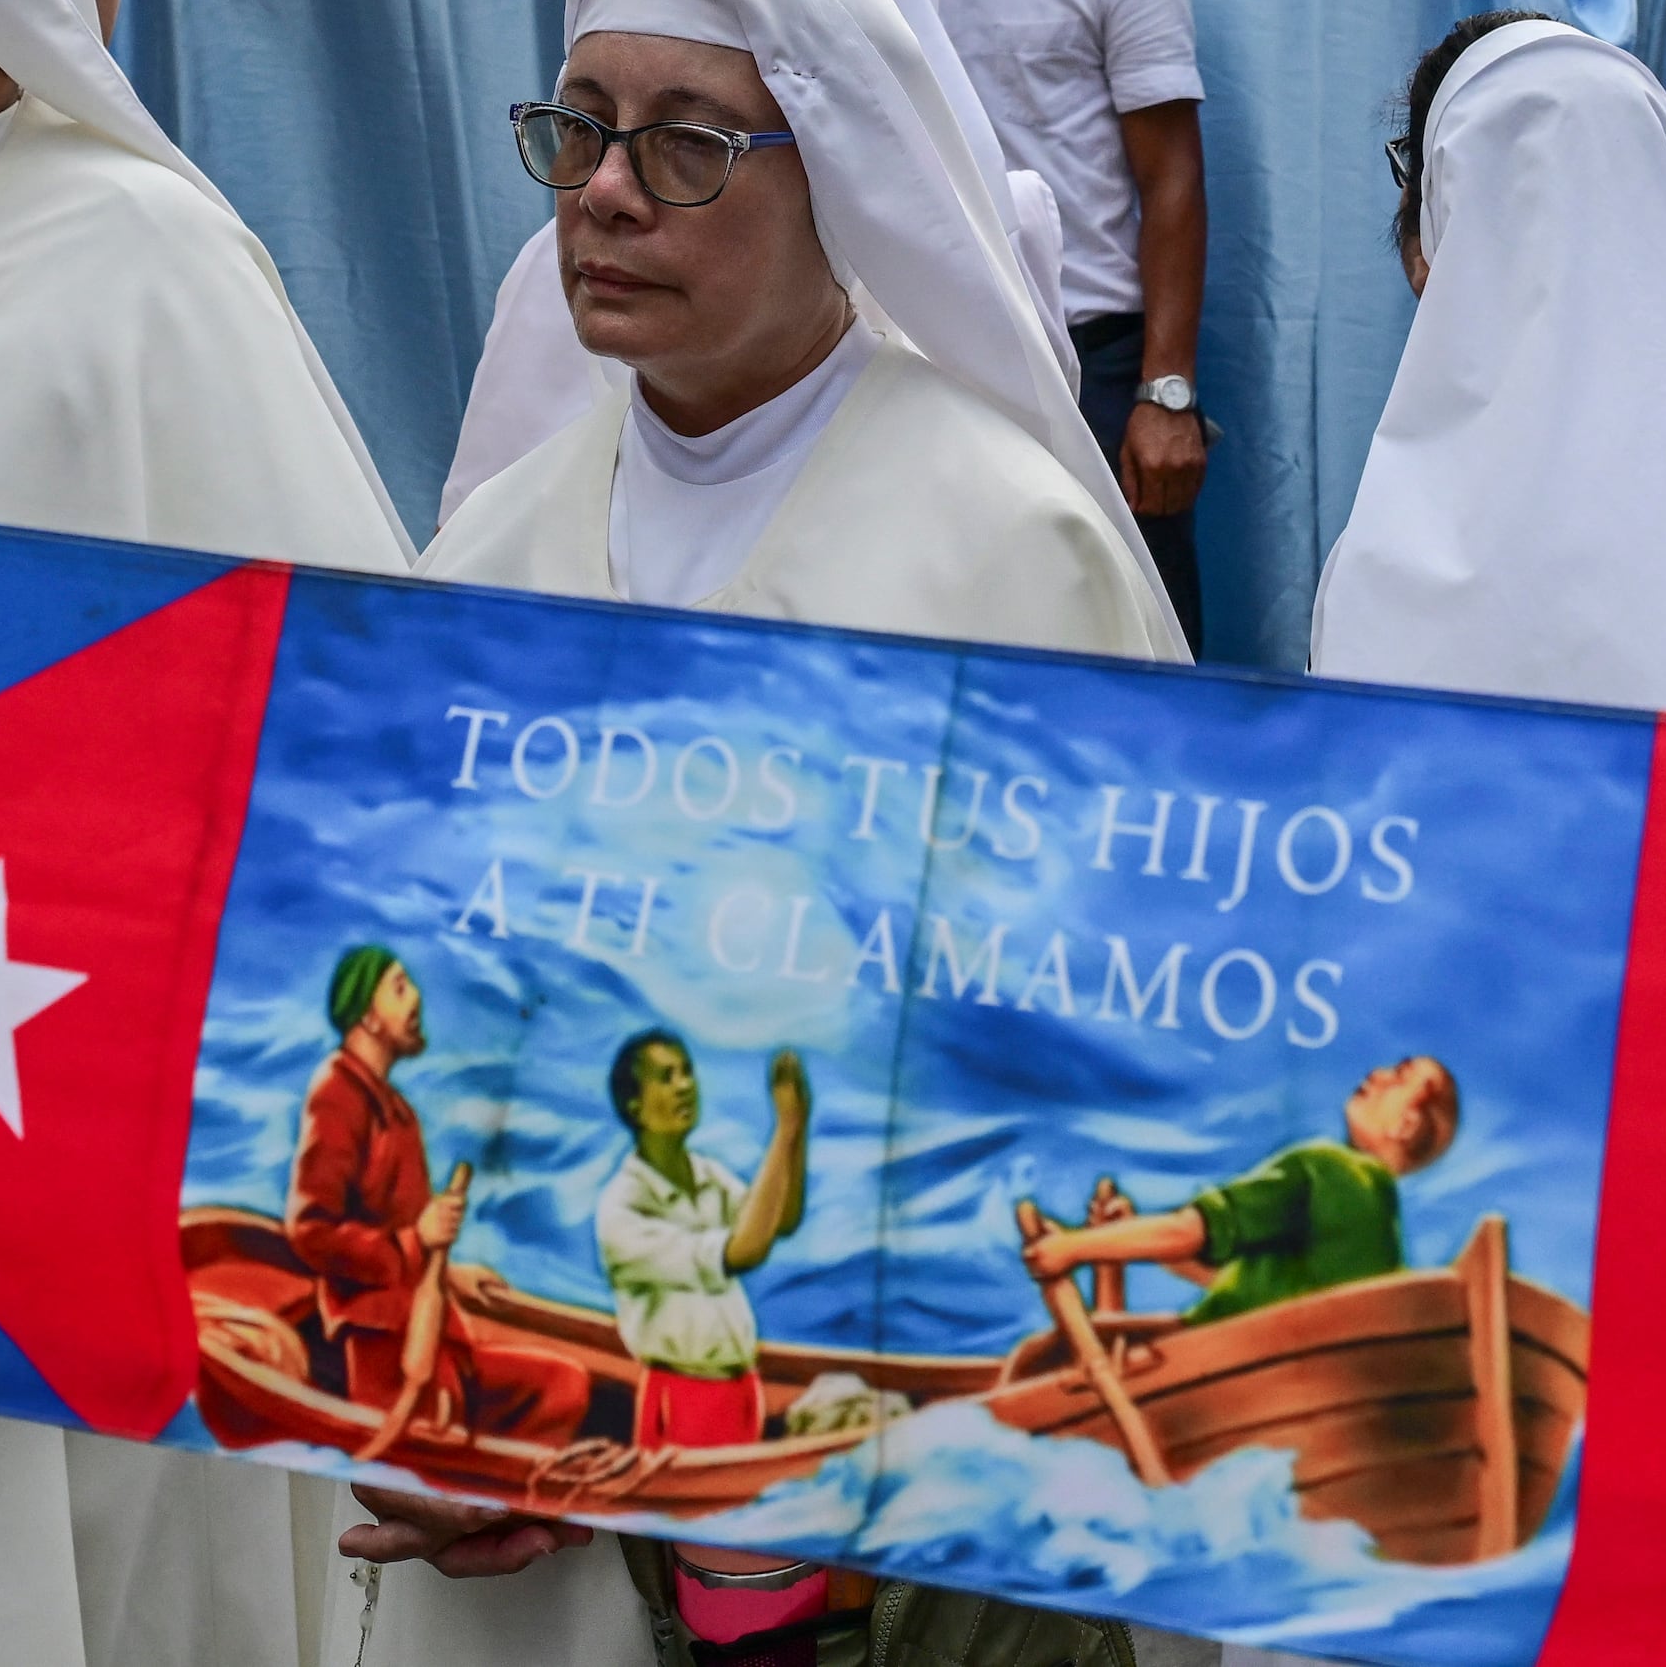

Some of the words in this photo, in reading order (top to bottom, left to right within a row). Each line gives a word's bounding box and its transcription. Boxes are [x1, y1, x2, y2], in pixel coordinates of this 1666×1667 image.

[445, 705, 801, 831] TODOS
[843, 754, 1048, 860] TUS
[1089, 783, 1420, 913] HIJOS
[451, 857, 510, 941] A
[562, 865, 659, 959] TI
[707, 880, 1344, 1050] CLAMAMOS
